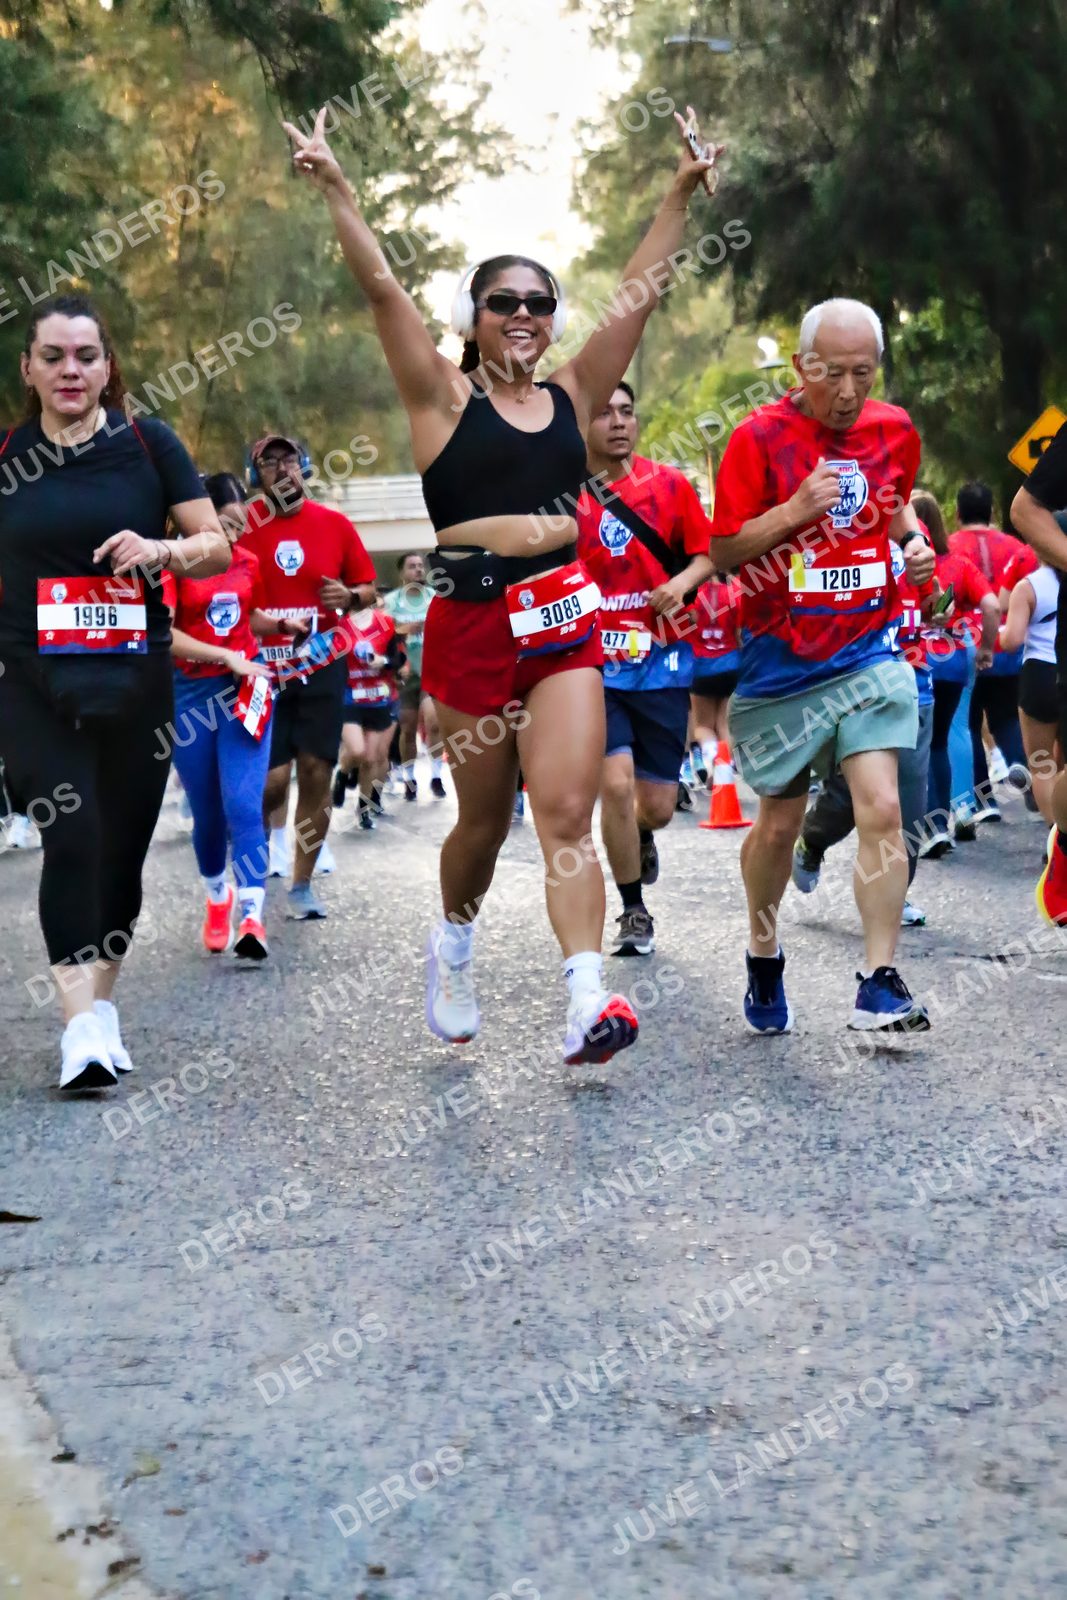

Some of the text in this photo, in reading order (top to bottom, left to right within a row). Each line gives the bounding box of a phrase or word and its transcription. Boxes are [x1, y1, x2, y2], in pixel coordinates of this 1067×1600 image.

[821, 567, 861, 590] 1209
[74, 605, 117, 627] 1996
[540, 595, 581, 628] 3089
[599, 631, 626, 647] 477
